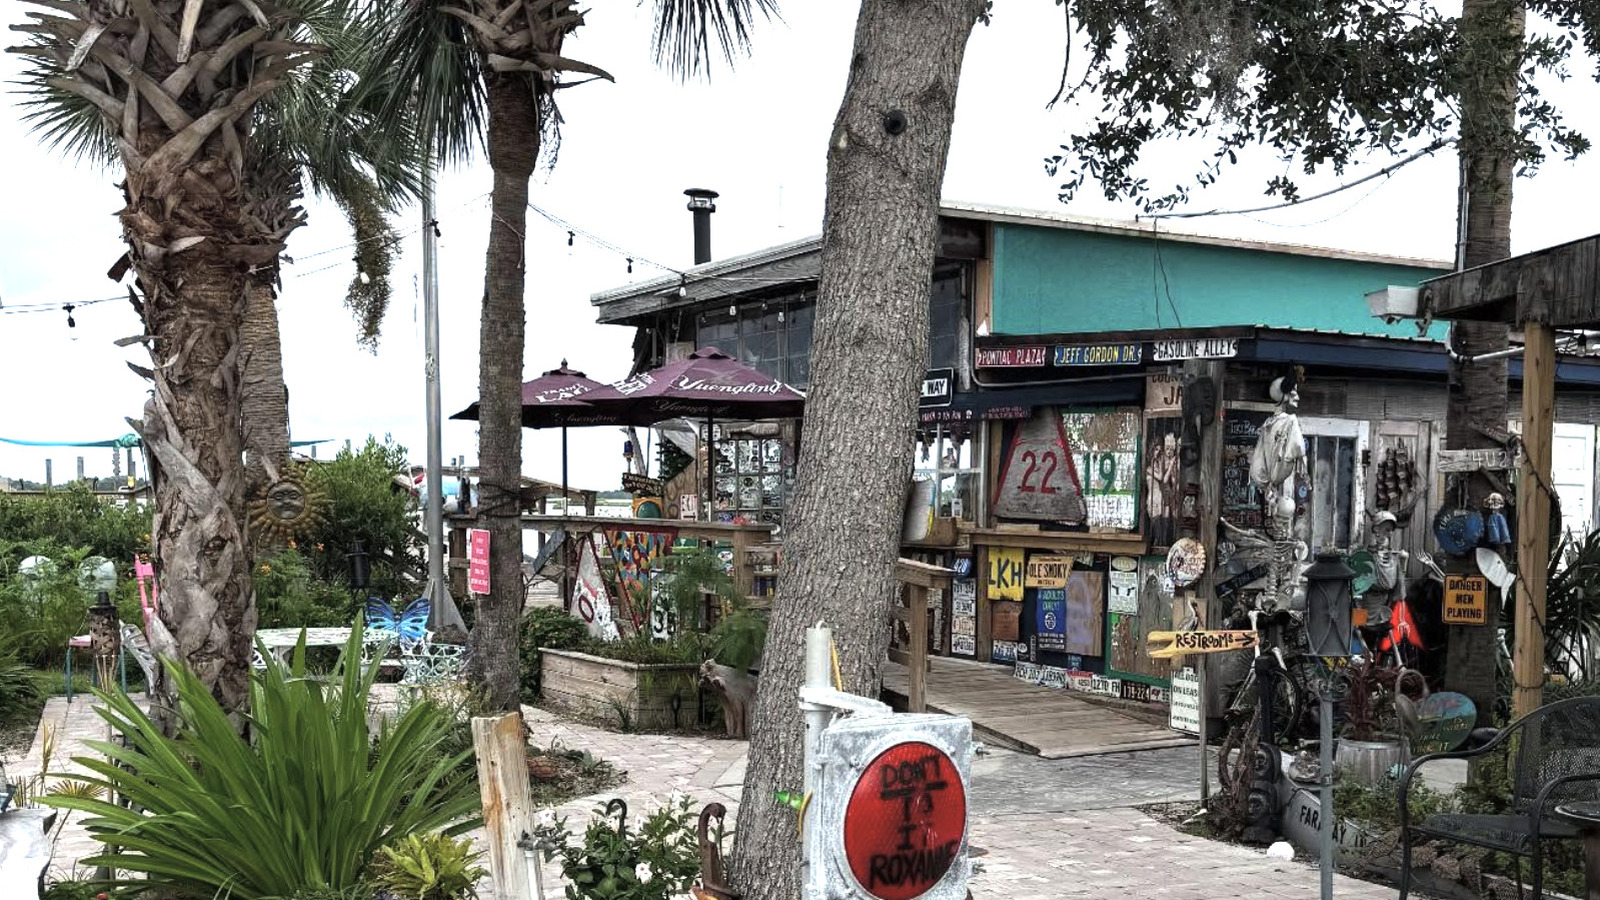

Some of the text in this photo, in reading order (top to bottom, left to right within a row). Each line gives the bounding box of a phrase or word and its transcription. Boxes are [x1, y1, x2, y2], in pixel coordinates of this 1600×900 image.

[982, 348, 1041, 365] PONTIAC PLAZA
[1060, 345, 1137, 363] JEFF GORDON DR.
[1158, 339, 1231, 358] GASOLINE ALLEY
[679, 375, 781, 395] Yuengling
[927, 380, 946, 394] WAY
[1020, 451, 1058, 494] 22
[989, 557, 1021, 588] LKH
[1043, 563, 1067, 578] SMOKY
[1449, 579, 1482, 591] DANGER
[1456, 593, 1474, 605] MEN
[1446, 607, 1482, 619] PLAYING
[1175, 632, 1233, 649] RESTROOMS
[1183, 686, 1198, 697] LEAS
[1300, 805, 1347, 845] FARAY
